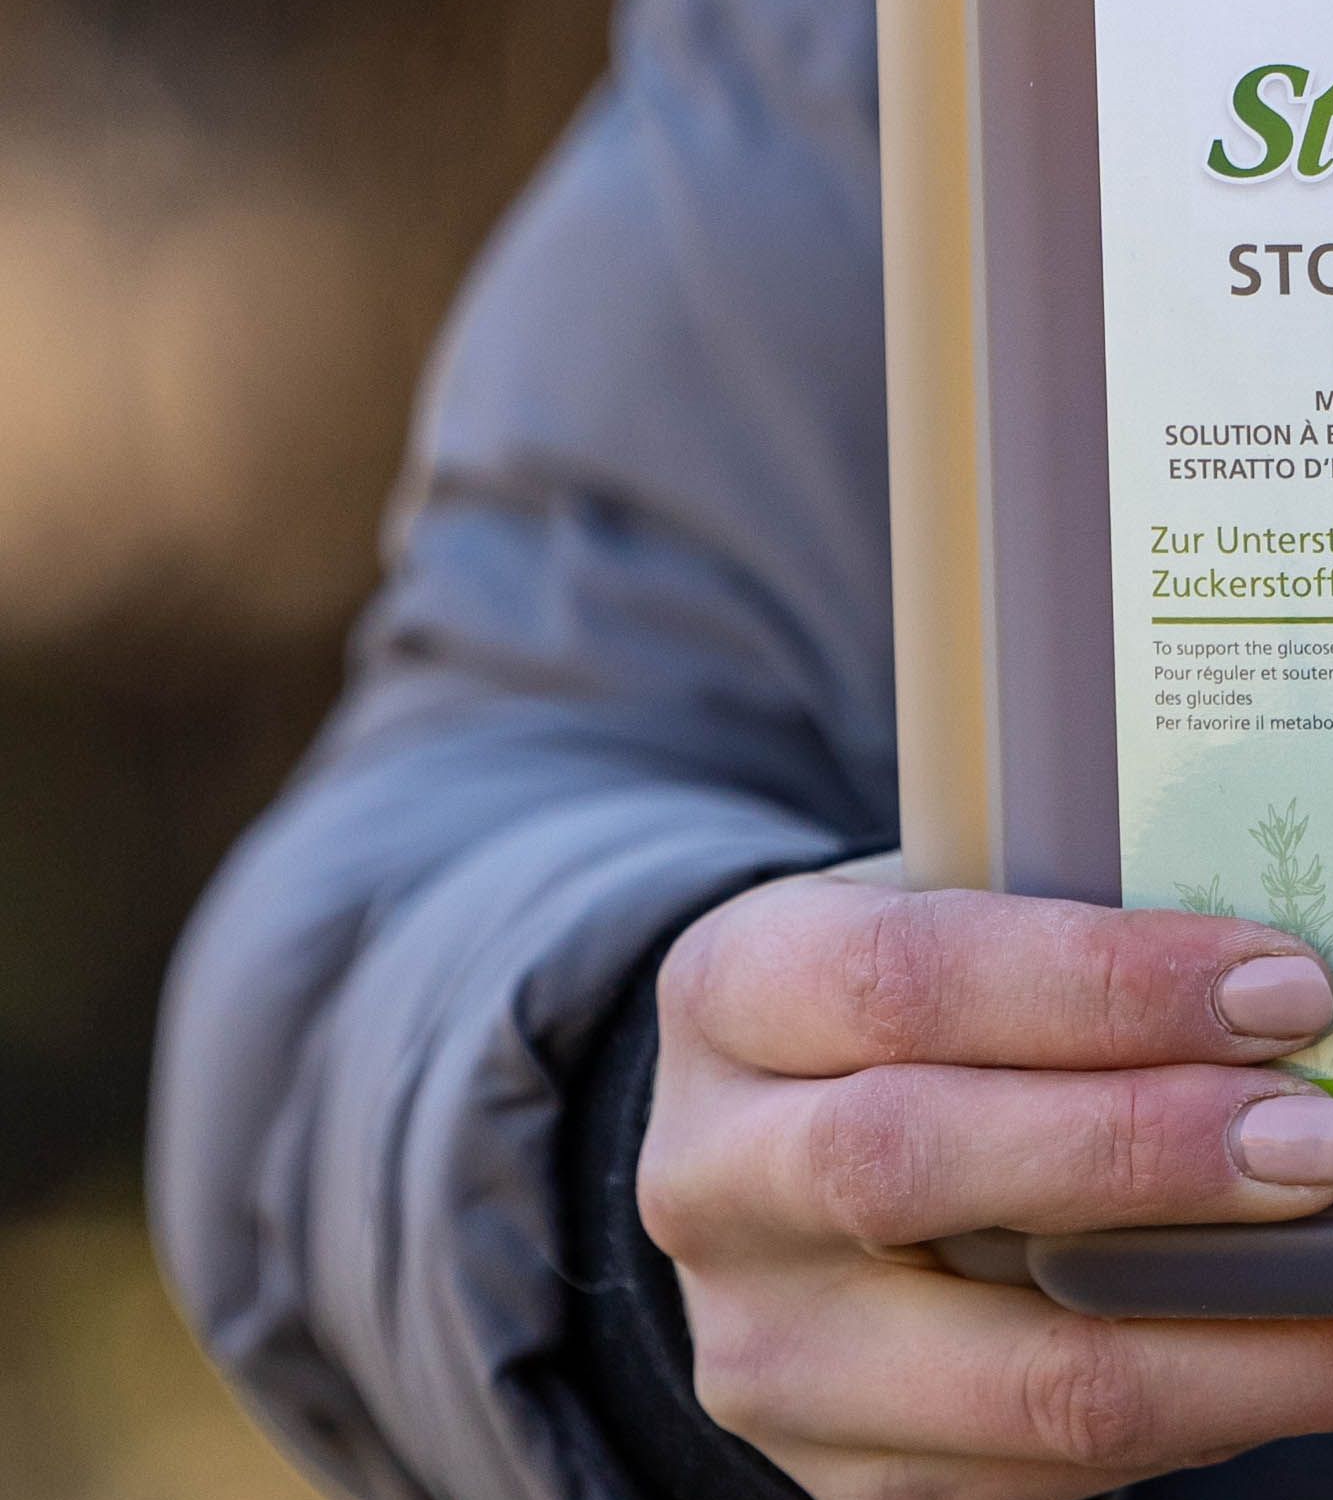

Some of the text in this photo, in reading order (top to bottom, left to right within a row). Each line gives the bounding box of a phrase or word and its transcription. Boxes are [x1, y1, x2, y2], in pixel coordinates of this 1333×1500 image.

[1165, 424, 1292, 446] SOLUTION
[1299, 416, 1319, 446] À
[1169, 457, 1296, 480] ESTRATTO
[1150, 525, 1206, 555] Zur
[1152, 640, 1172, 656] To
[1176, 641, 1240, 659] support
[1244, 639, 1273, 656] the
[1154, 664, 1193, 681] Pour
[1196, 664, 1257, 684] réguler
[1260, 665, 1278, 681] et
[1154, 688, 1253, 710] des glucides
[1155, 715, 1182, 731] Per
[1186, 713, 1251, 731] favorire
[1255, 714, 1265, 731] il
